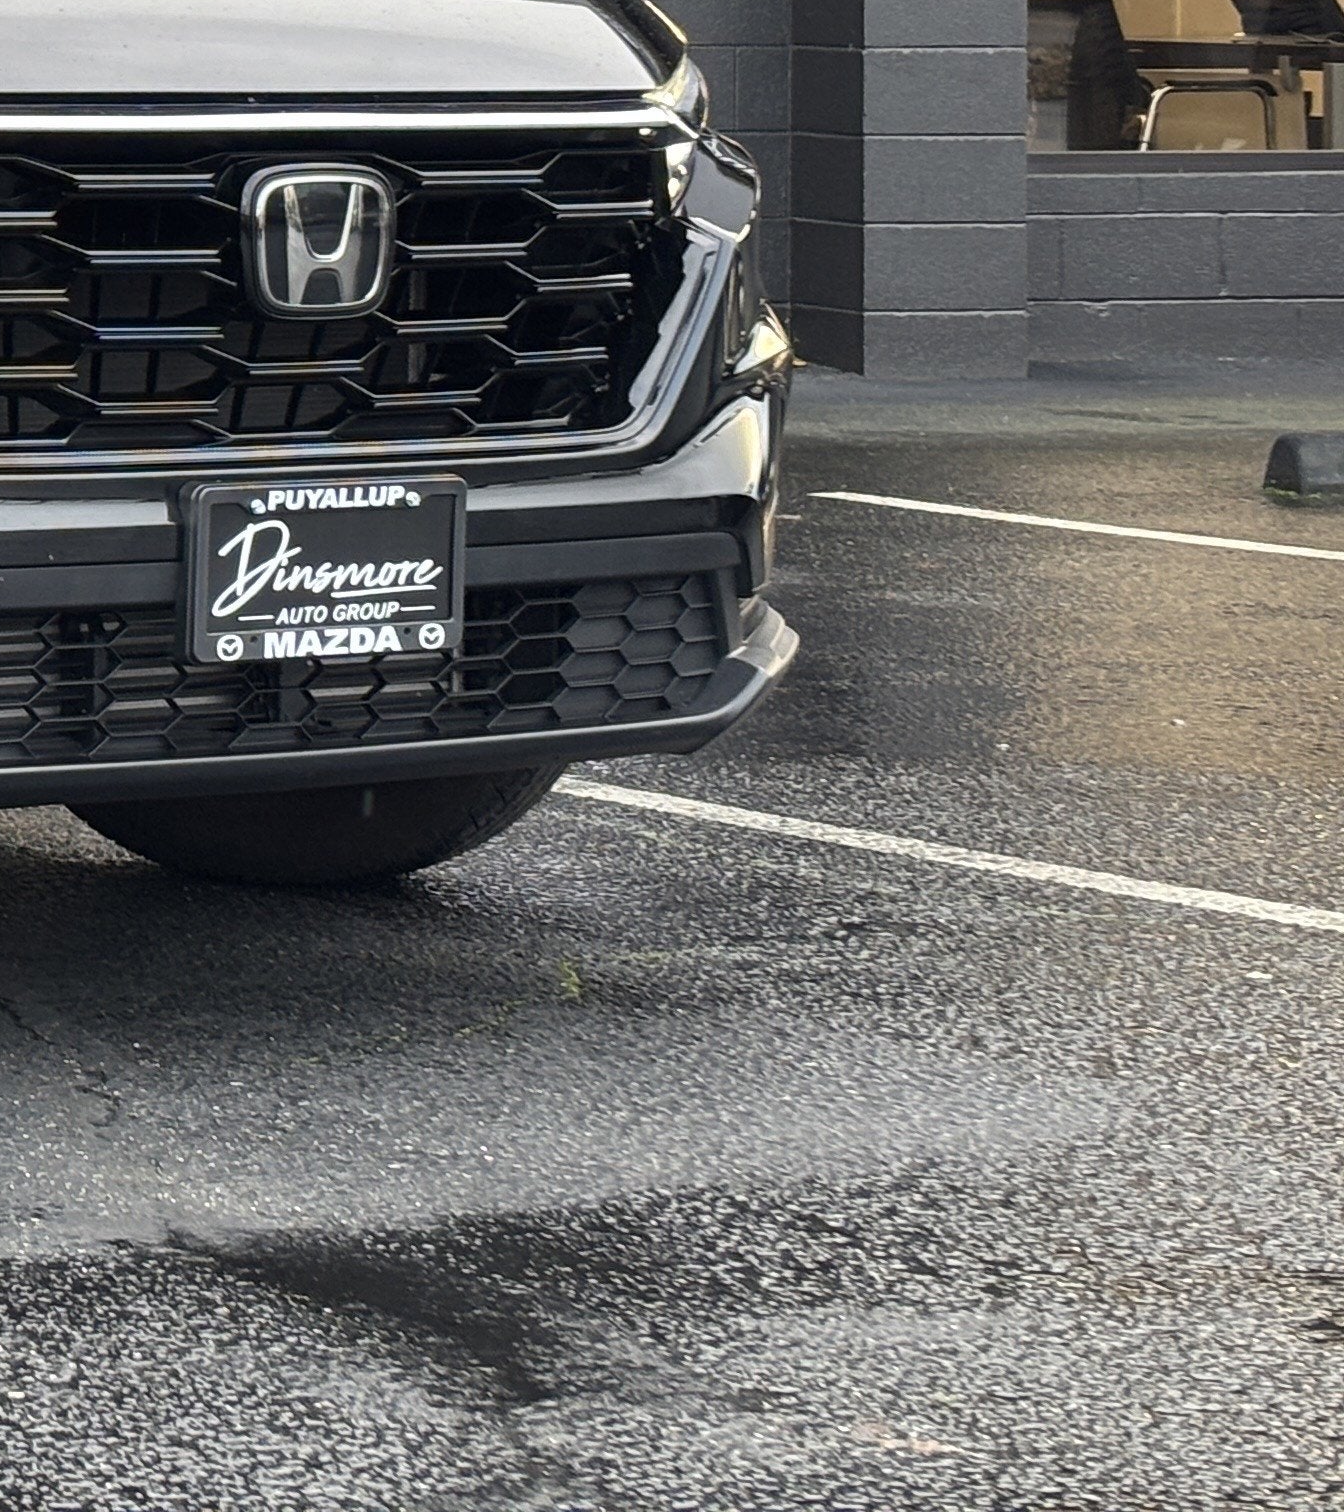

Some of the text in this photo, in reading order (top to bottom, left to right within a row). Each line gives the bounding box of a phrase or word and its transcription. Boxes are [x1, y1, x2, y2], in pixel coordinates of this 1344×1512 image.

[267, 485, 405, 511] PUYALLUP
[211, 519, 444, 618] Dinsmore
[275, 601, 401, 626] AUTO GROUP
[263, 625, 404, 659] MAZDA
